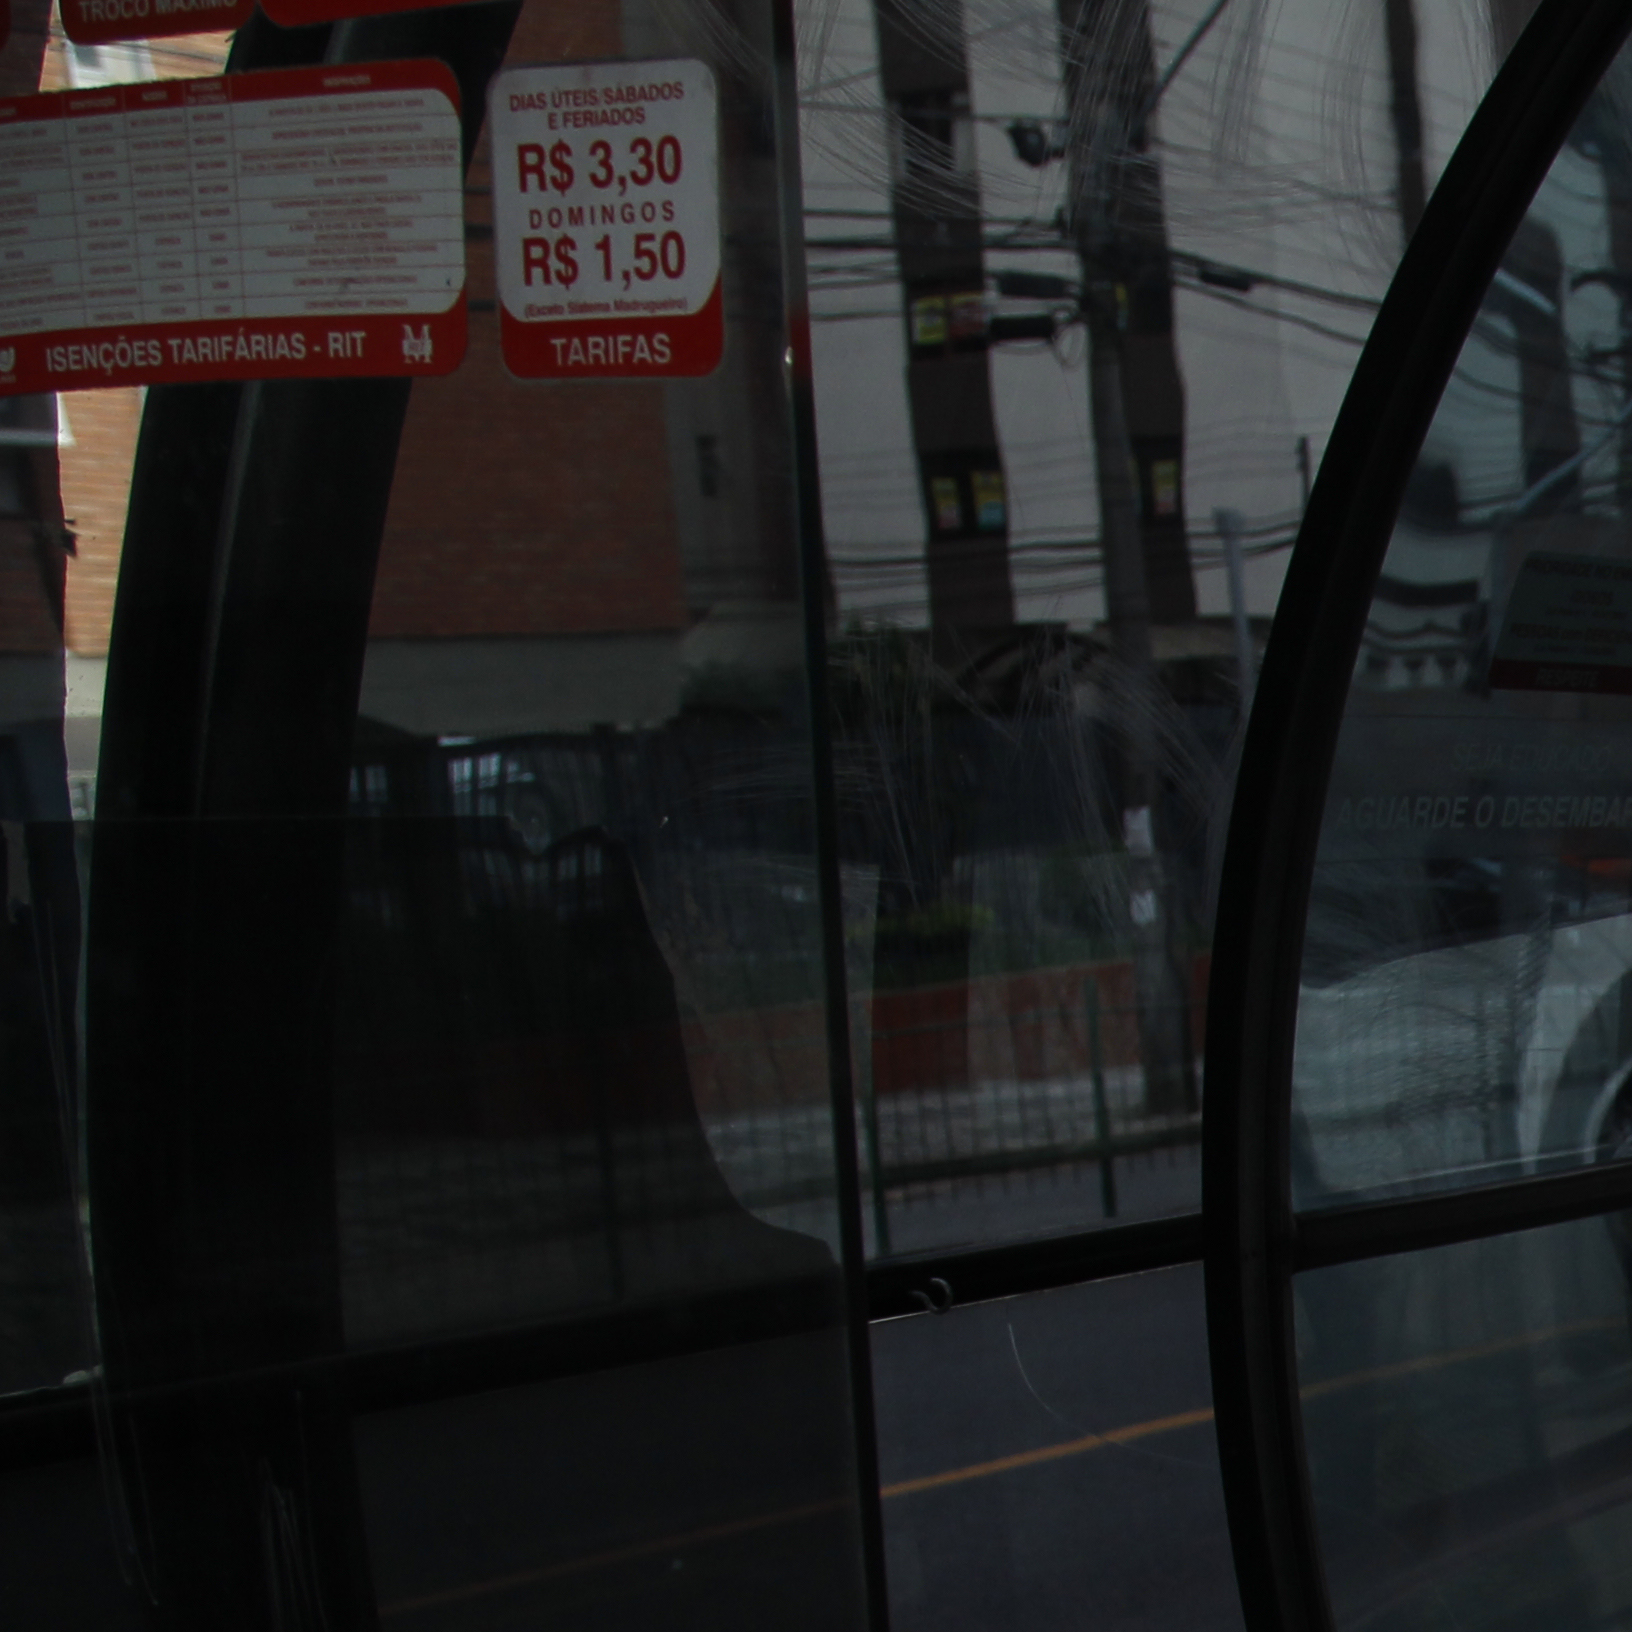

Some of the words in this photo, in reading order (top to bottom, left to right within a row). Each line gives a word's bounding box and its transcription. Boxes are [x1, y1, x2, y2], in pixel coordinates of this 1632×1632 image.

[79, 0, 148, 23] TROCO
[509, 92, 547, 112] DIAS
[547, 111, 559, 130] E
[562, 106, 646, 128] FERIADOS
[517, 137, 575, 197] R$
[588, 134, 683, 197] 3,30
[529, 200, 675, 229] DOMINGOS
[522, 232, 580, 291] R$
[594, 230, 686, 292] 1,50
[45, 335, 163, 377] ISENÇÕES
[168, 327, 307, 364] TARIFÁRIAS
[327, 331, 367, 358] RIT
[550, 332, 672, 367] TARIFAS
[1336, 796, 1469, 829] AGUARDE
[1475, 795, 1495, 829] O
